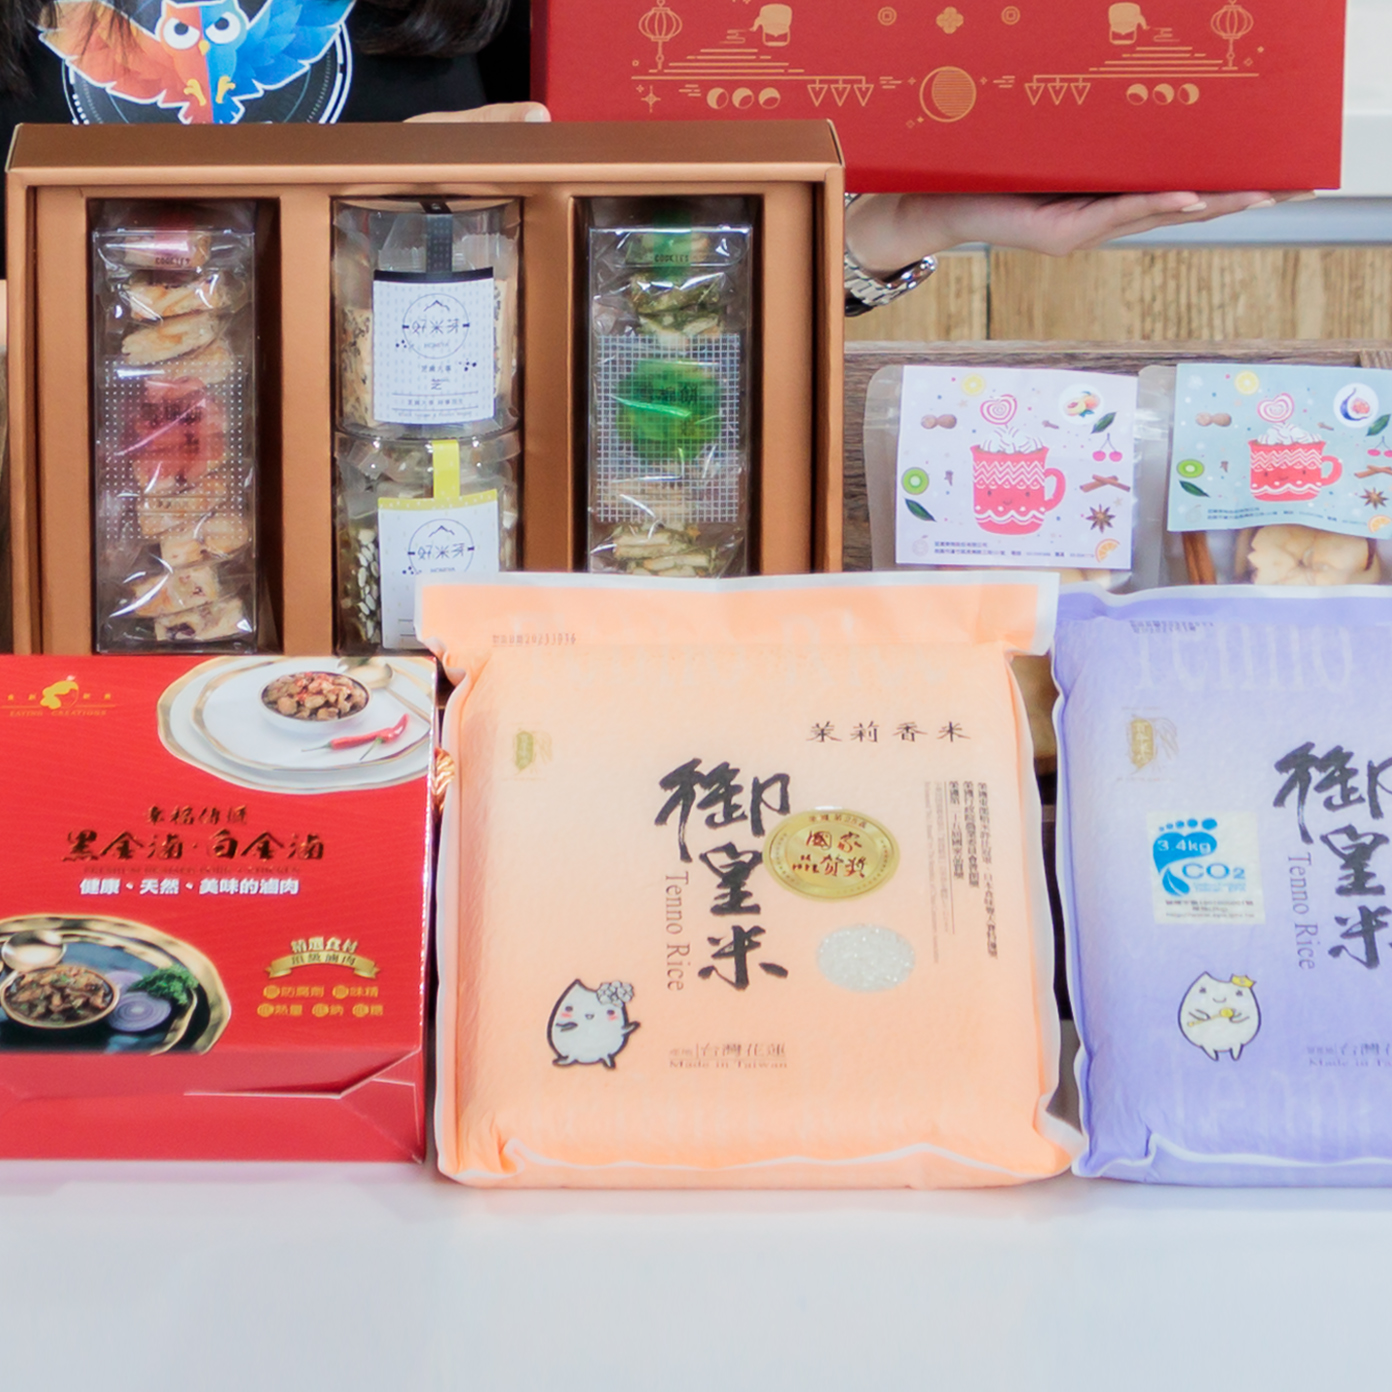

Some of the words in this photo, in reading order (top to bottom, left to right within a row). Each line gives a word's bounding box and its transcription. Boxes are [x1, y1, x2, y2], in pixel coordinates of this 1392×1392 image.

[412, 318, 460, 335] 好米芽
[417, 542, 466, 561] 好米芽
[806, 720, 972, 743] 茉莉香米
[1157, 839, 1212, 855] 3.4kg
[654, 757, 791, 991] 御皇米
[1287, 852, 1313, 916] Tenno
[665, 871, 690, 935] Tenno
[1294, 922, 1321, 971] Rice
[666, 943, 691, 991] Rice
[737, 1059, 788, 1070] Taiwan
